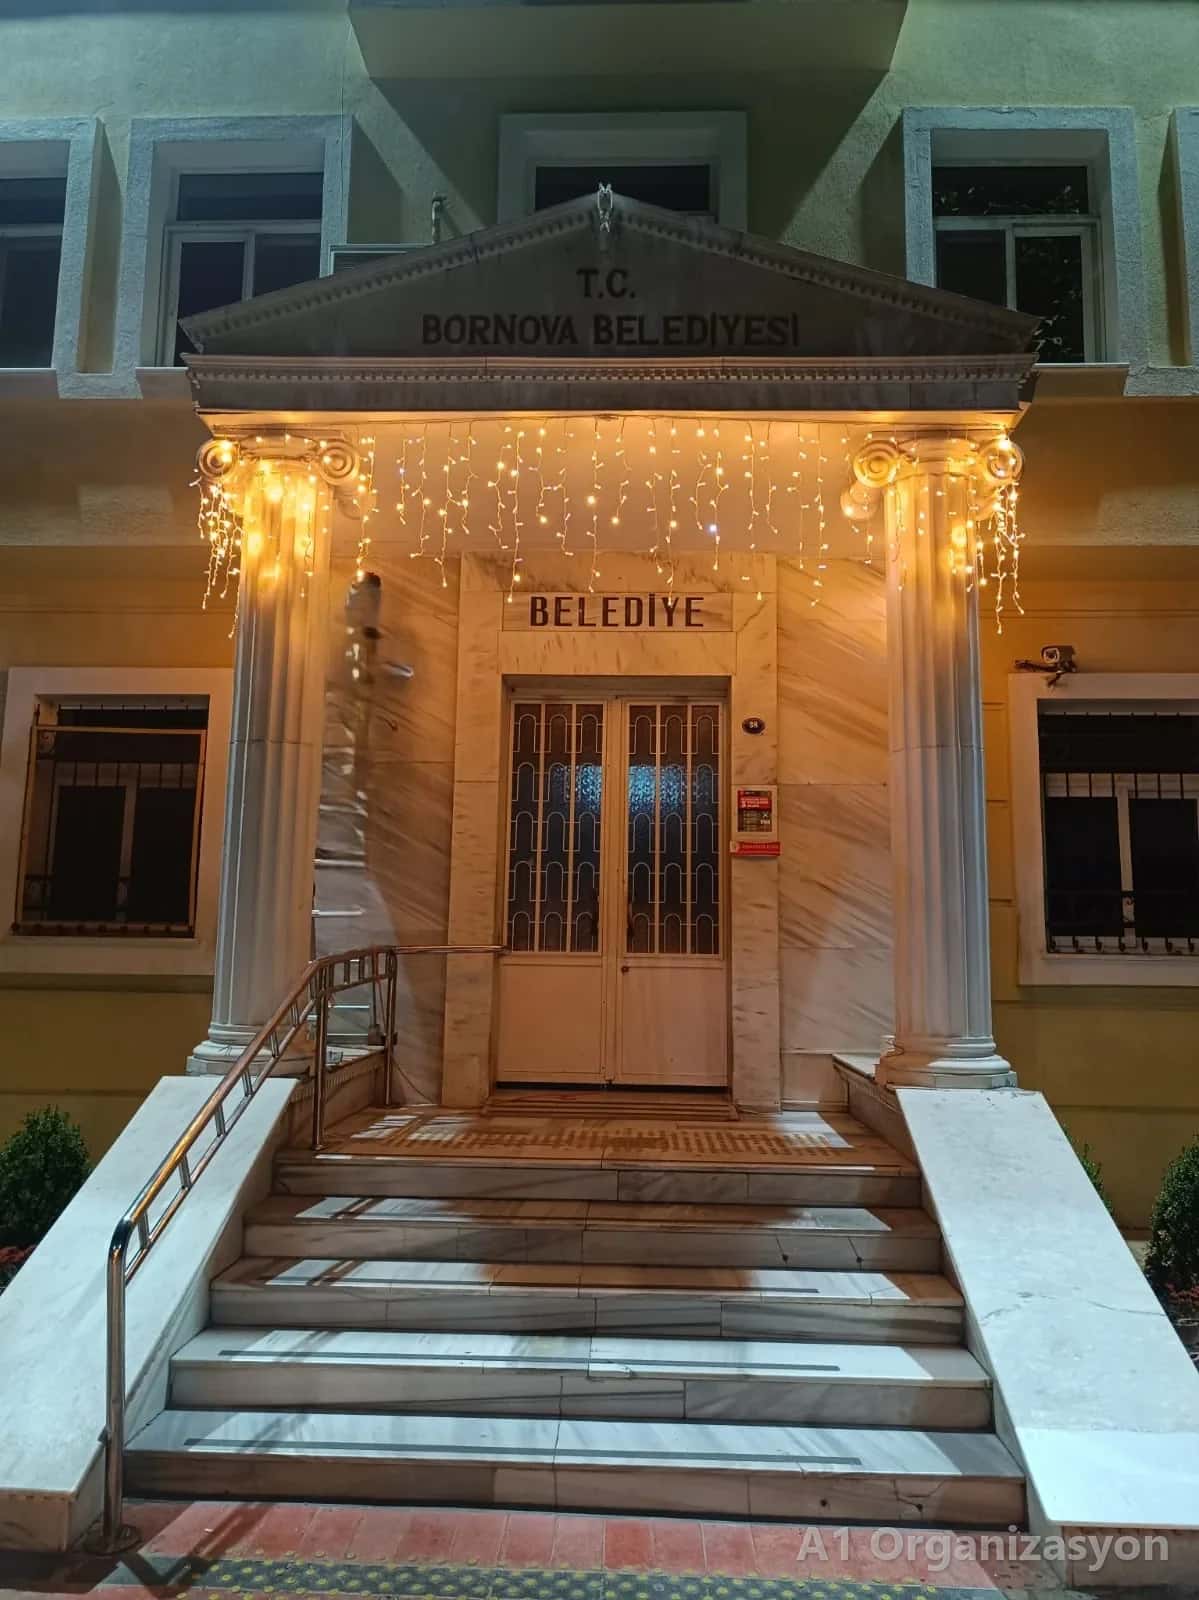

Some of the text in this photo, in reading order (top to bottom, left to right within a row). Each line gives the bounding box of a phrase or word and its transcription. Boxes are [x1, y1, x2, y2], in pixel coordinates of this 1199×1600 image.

[576, 268, 636, 298] T.C.
[422, 311, 799, 347] BORNOVA BELEDİYESİ
[530, 593, 704, 627] BELEDİYE
